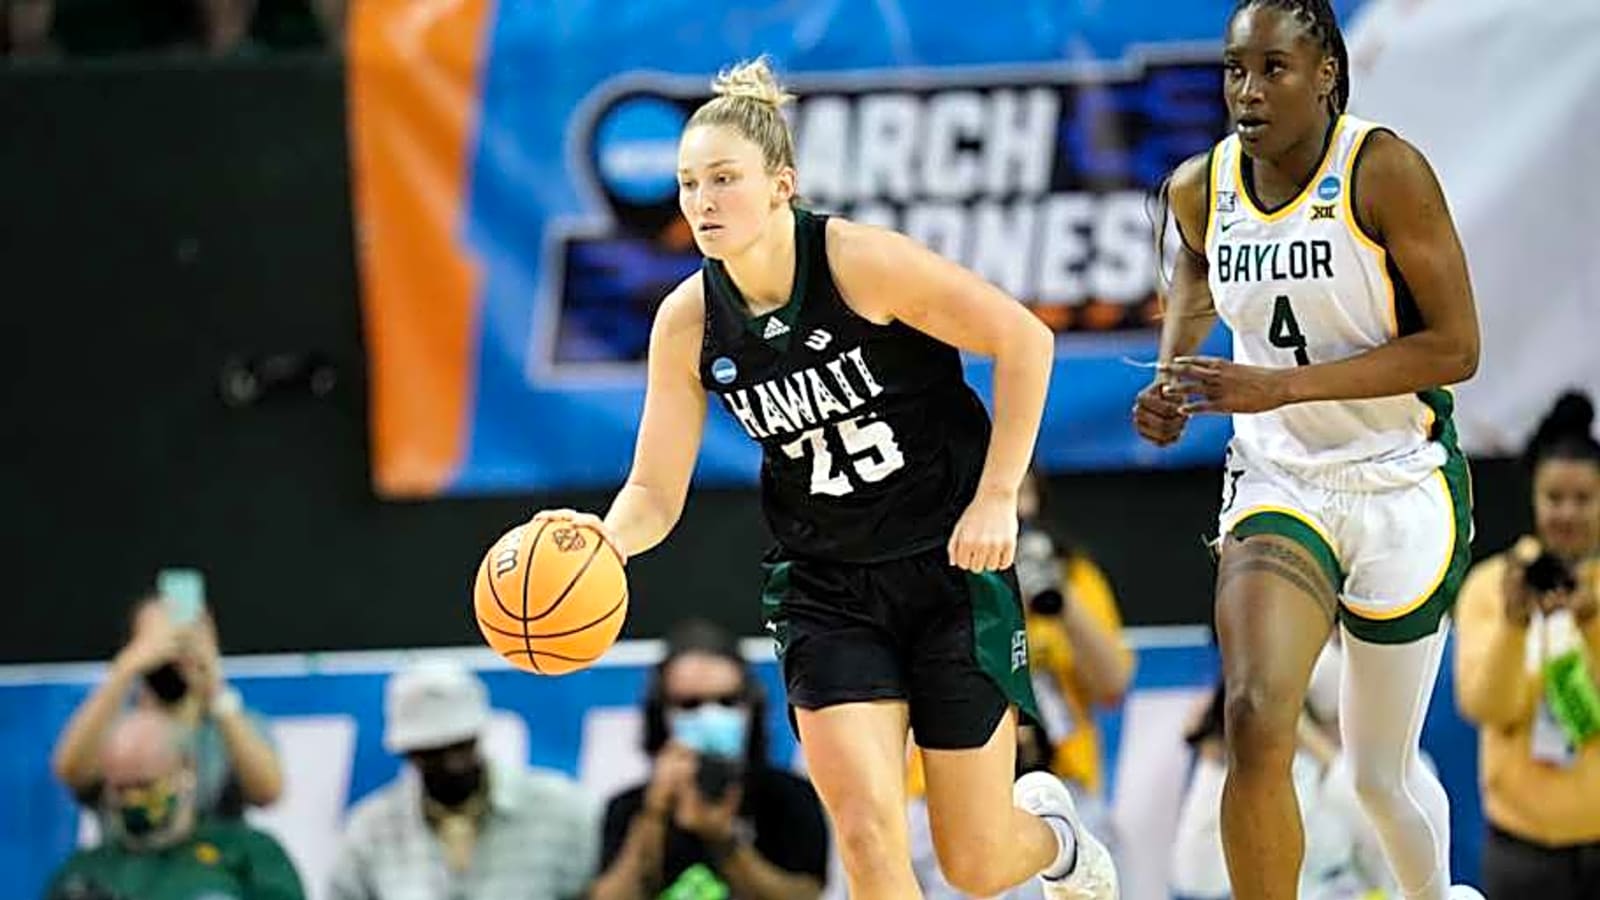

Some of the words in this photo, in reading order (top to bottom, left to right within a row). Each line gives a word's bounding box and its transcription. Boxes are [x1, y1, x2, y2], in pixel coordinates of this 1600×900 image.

[798, 88, 1058, 200] ARCH
[1217, 240, 1334, 283] BAYLOR
[1268, 295, 1310, 366] 4
